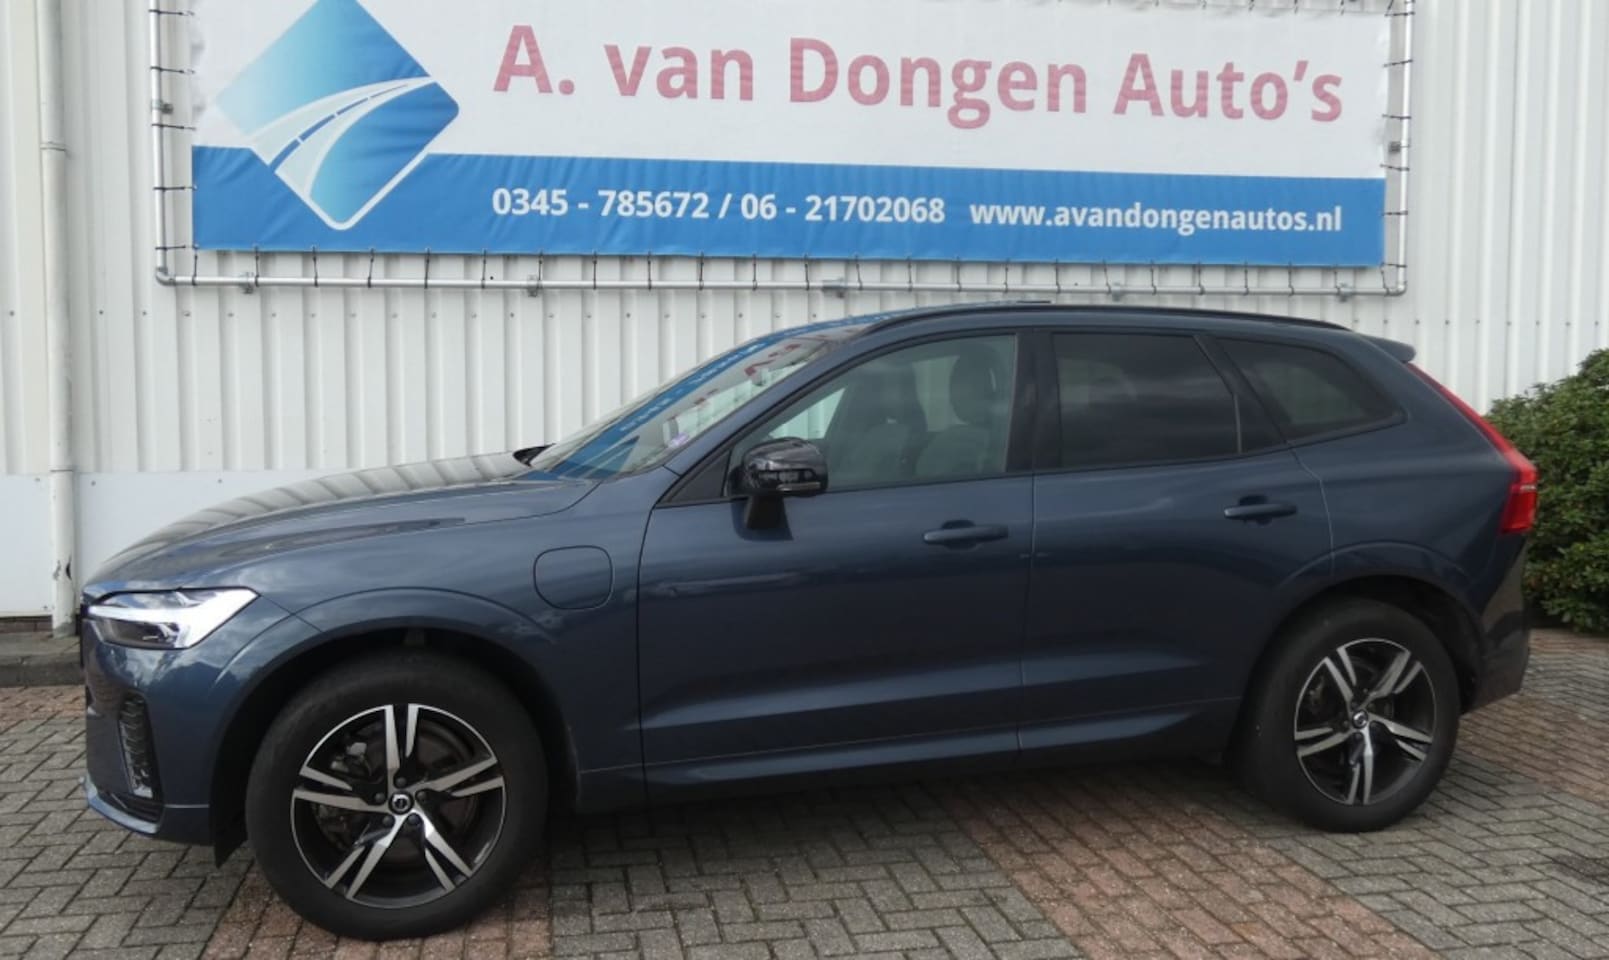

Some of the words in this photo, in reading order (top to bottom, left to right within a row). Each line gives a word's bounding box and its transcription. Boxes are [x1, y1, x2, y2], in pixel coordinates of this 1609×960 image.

[493, 25, 575, 95] A.
[604, 44, 753, 101] van
[789, 37, 1087, 129] Dongen
[1113, 53, 1343, 122] Auto's
[491, 187, 568, 216] 0345
[598, 190, 709, 219] 785672
[718, 194, 732, 219] /
[740, 194, 777, 220] 06
[805, 195, 945, 224] 21702068
[970, 202, 1342, 236] www.avandongenautos.nl
